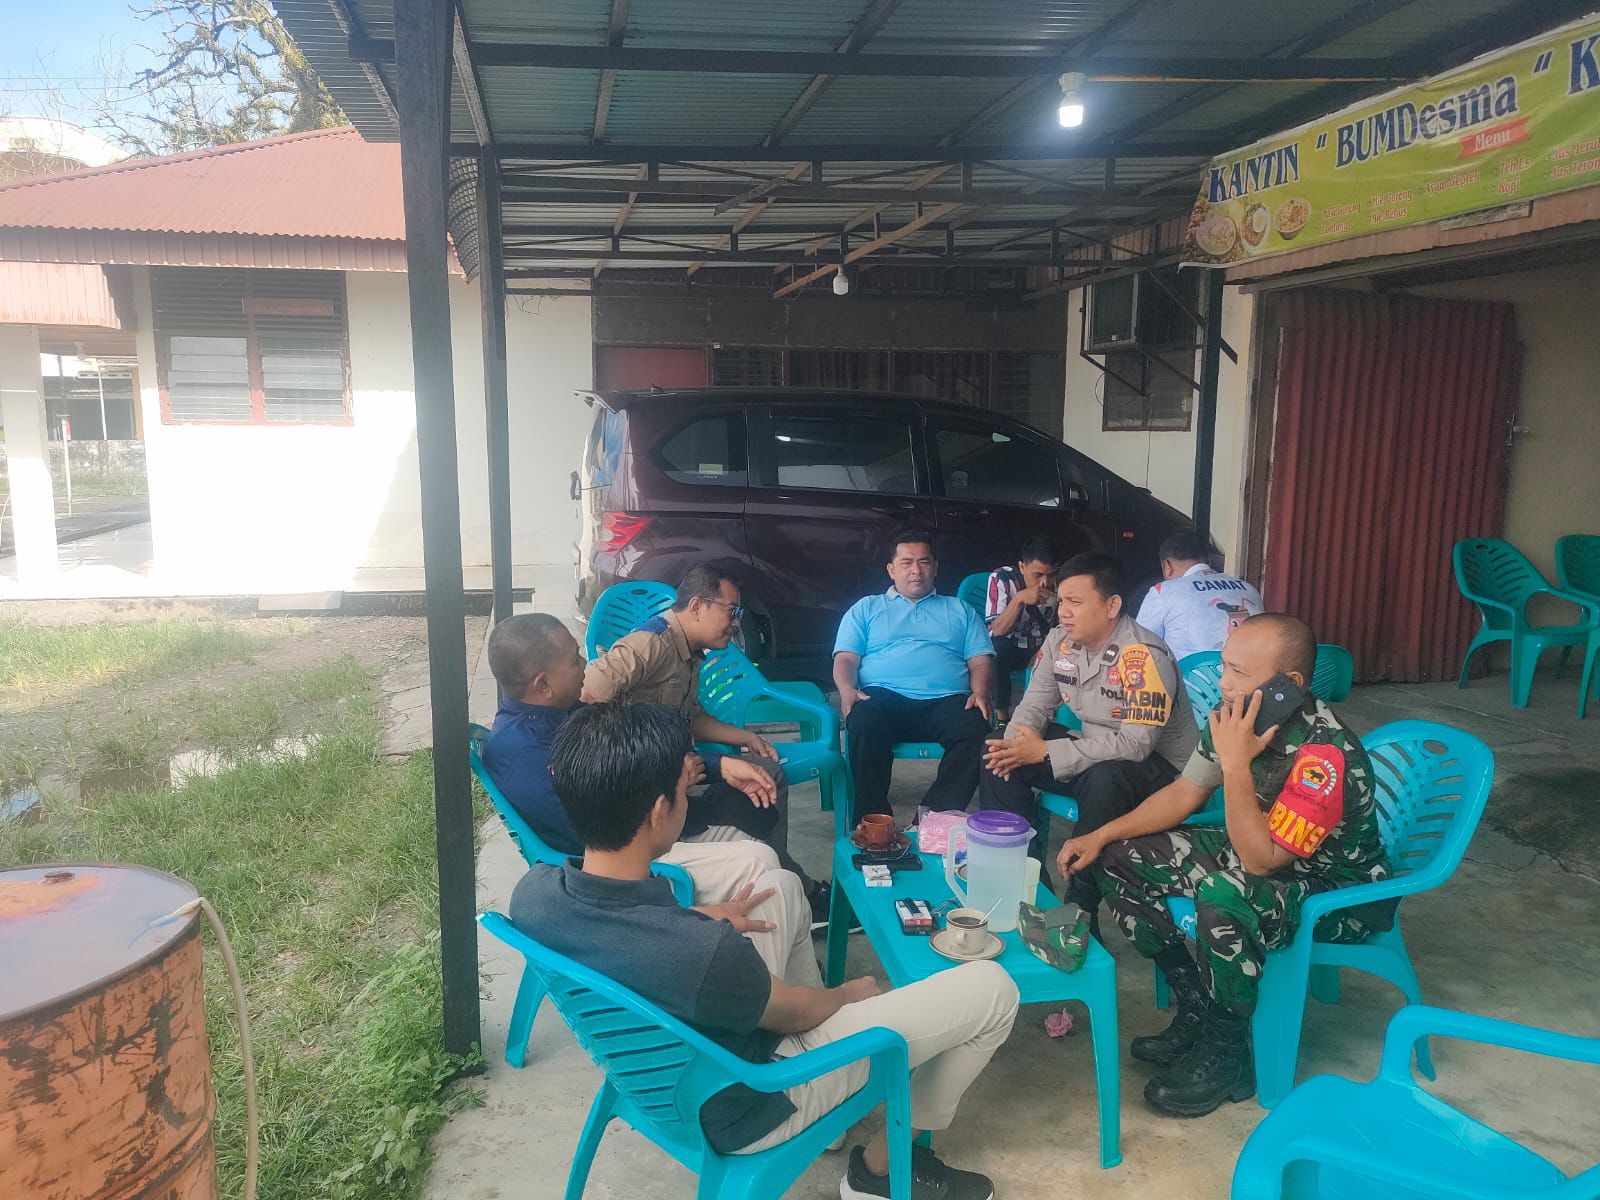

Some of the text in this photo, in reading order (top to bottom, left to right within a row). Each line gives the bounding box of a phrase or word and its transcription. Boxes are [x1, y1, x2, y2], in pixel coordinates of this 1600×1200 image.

[1209, 143, 1300, 204] KANTIN
[1335, 74, 1518, 169] BUMDesma
[1474, 130, 1511, 152] Menu
[1552, 146, 1571, 161] Jus
[1500, 156, 1531, 176] Teh Es
[1550, 166, 1569, 181] Jus
[1498, 178, 1521, 195] Kopi
[1385, 190, 1413, 204] Goreng
[1192, 580, 1247, 592] CAMAT
